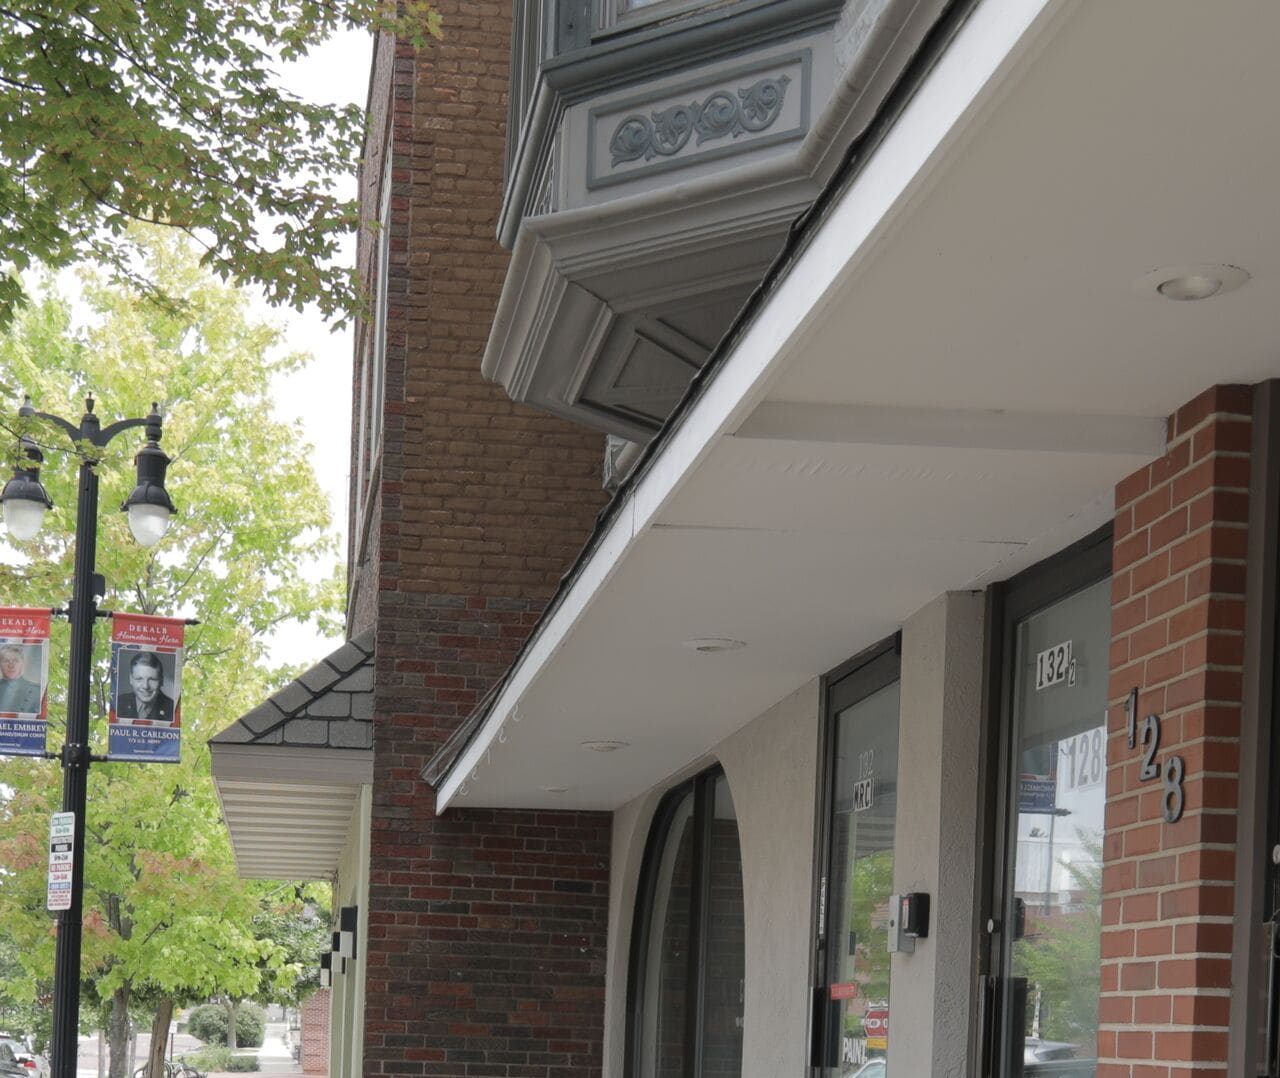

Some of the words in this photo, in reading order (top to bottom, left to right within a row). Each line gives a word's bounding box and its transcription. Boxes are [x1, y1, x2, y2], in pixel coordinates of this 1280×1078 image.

[129, 624, 168, 634] DEKALB
[13, 724, 47, 732] EMBREY
[110, 728, 131, 737] PAUL
[141, 730, 180, 739] CARLSON
[1068, 728, 1102, 790] 128
